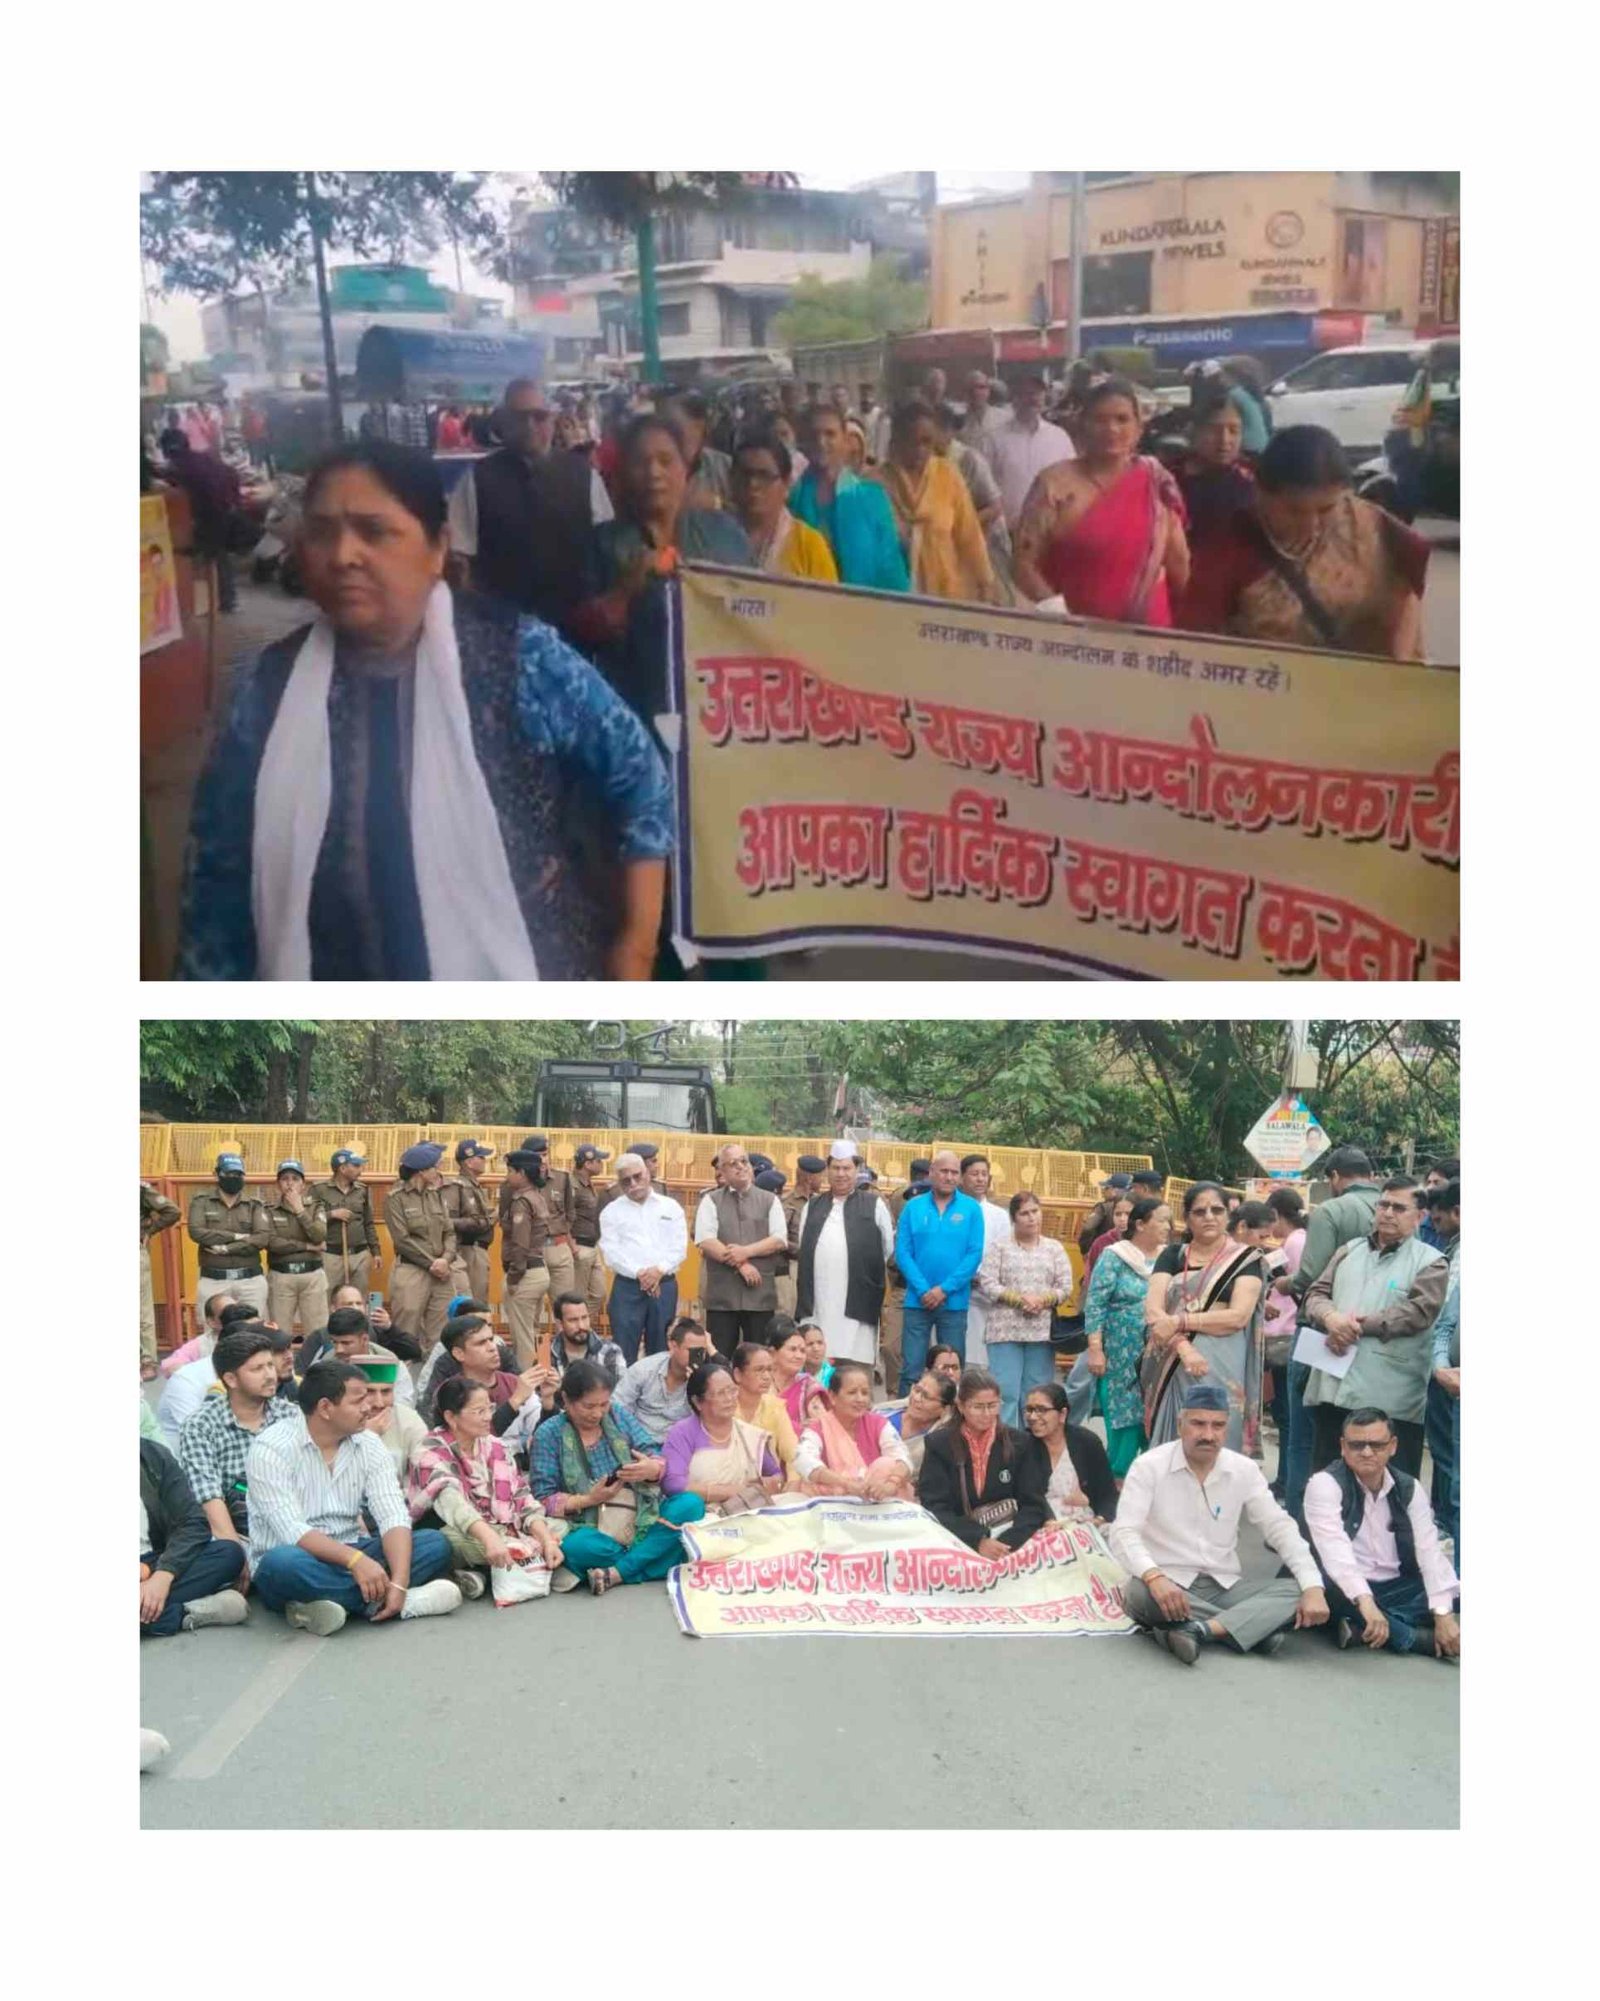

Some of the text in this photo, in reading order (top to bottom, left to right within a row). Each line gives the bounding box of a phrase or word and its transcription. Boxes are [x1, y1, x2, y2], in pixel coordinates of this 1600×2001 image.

[996, 632, 1033, 652] राज्य
[1146, 648, 1192, 679] शहीद
[1200, 659, 1246, 687] अमर
[695, 656, 916, 760] उत्तराखण्ड
[912, 700, 1044, 788] राज्य
[735, 802, 893, 898] आपका
[898, 786, 1061, 909] हार्दिक
[1063, 836, 1254, 959] स्वागत
[1257, 880, 1426, 981] करता
[688, 1548, 819, 1596] उत्तराखण्ड
[819, 1549, 890, 1595] राज्य
[720, 1601, 826, 1624] आपका
[820, 1598, 921, 1625] हार्दिक
[916, 1606, 1027, 1625] स्वागत
